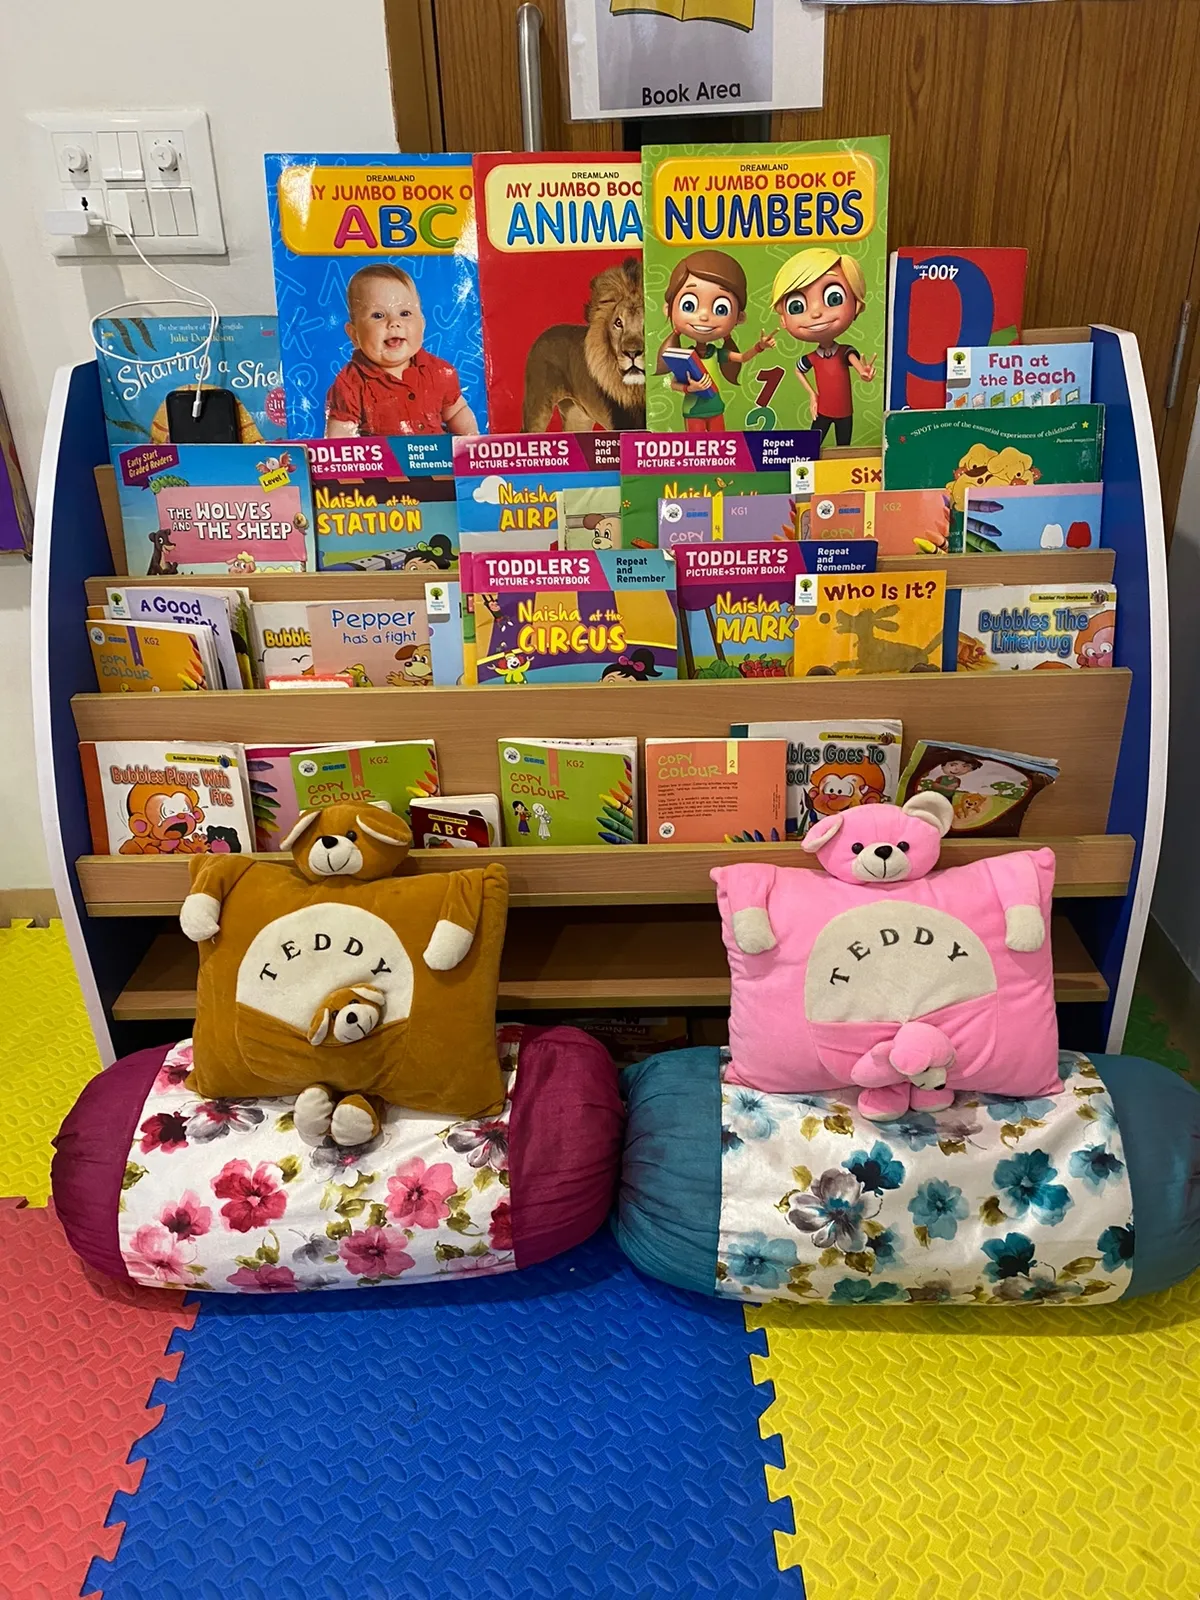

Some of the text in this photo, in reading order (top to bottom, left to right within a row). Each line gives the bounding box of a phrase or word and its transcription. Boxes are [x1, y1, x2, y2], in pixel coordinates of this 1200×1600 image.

[642, 82, 741, 106] Book Area
[572, 171, 620, 180] DREAMLAND
[740, 164, 788, 172] DREAMLAND
[366, 174, 416, 183] DREAMLAND
[673, 171, 856, 192] MY JUMBO BOOK OF
[332, 186, 396, 202] JUMBO
[402, 185, 456, 200] BOOK
[506, 182, 532, 199] MY
[536, 182, 600, 198] JUMBO
[664, 190, 864, 240] NUMBERS
[333, 204, 459, 250] ABC
[190, 332, 234, 342] Donldson
[988, 353, 1050, 369] Fun at
[117, 350, 212, 401] Sharing
[218, 360, 230, 373] a
[980, 368, 1076, 386] the Beach
[972, 424, 1000, 436] essential
[1000, 431, 1036, 440] experiences
[1036, 430, 1044, 438] of
[408, 444, 438, 452] Repeat
[466, 440, 569, 459] TODDLER'S
[634, 440, 737, 458] TODDLER'S
[763, 439, 794, 448] Repeat
[127, 450, 158, 468] Early Start
[408, 452, 424, 460] and
[595, 448, 611, 456] and
[762, 448, 779, 456] and
[128, 454, 174, 478] Graded Readers
[762, 456, 810, 465] Remember
[262, 476, 280, 488] Level
[850, 466, 882, 484] Six
[314, 486, 420, 510] Naisha at the
[167, 502, 272, 520] THE WOLVES
[730, 506, 748, 516] KG1
[882, 502, 902, 512] KG2
[172, 521, 293, 540] AND THE SHEEP
[317, 509, 422, 536] STATION
[866, 520, 872, 530] 2
[669, 530, 704, 543] COPY
[820, 528, 856, 539] COPY
[686, 548, 788, 566] TODDLER'S
[818, 548, 850, 556] Repeat
[486, 558, 590, 576] TODDLER'S
[616, 557, 648, 566] Repeat
[816, 563, 866, 572] Remember
[616, 566, 633, 574] and
[760, 566, 786, 575] BOOK
[616, 574, 666, 583] Remember
[824, 583, 875, 601] Who
[882, 583, 898, 600] Is
[906, 581, 937, 600] It?
[140, 600, 152, 612] A
[153, 596, 202, 616] Good
[518, 599, 624, 623] Naisha at the
[715, 591, 780, 616] Naisha
[332, 608, 416, 631] Pepper
[978, 606, 1089, 632] Bubbles The
[343, 630, 417, 646] has a fight
[716, 616, 796, 645] MARK
[144, 636, 160, 646] KG2
[518, 624, 628, 655] CIRCUS
[992, 630, 1073, 659] Litterbug
[100, 654, 128, 666] COPY
[102, 665, 153, 680] COLOUR
[369, 756, 390, 765] KG2
[658, 752, 693, 767] COPY
[786, 742, 886, 764] bles Goes To
[566, 760, 584, 768] KG2
[729, 760, 736, 768] 2
[110, 764, 232, 788] Bubbles Plays With
[510, 772, 542, 786] COPY
[658, 765, 722, 780] COLOUR
[308, 780, 344, 795] COPY
[510, 783, 570, 800] COLOUR
[209, 787, 234, 808] Fire
[309, 789, 376, 806] COLOUR
[259, 933, 392, 982] TEDDY
[830, 926, 969, 986] TEDDY
